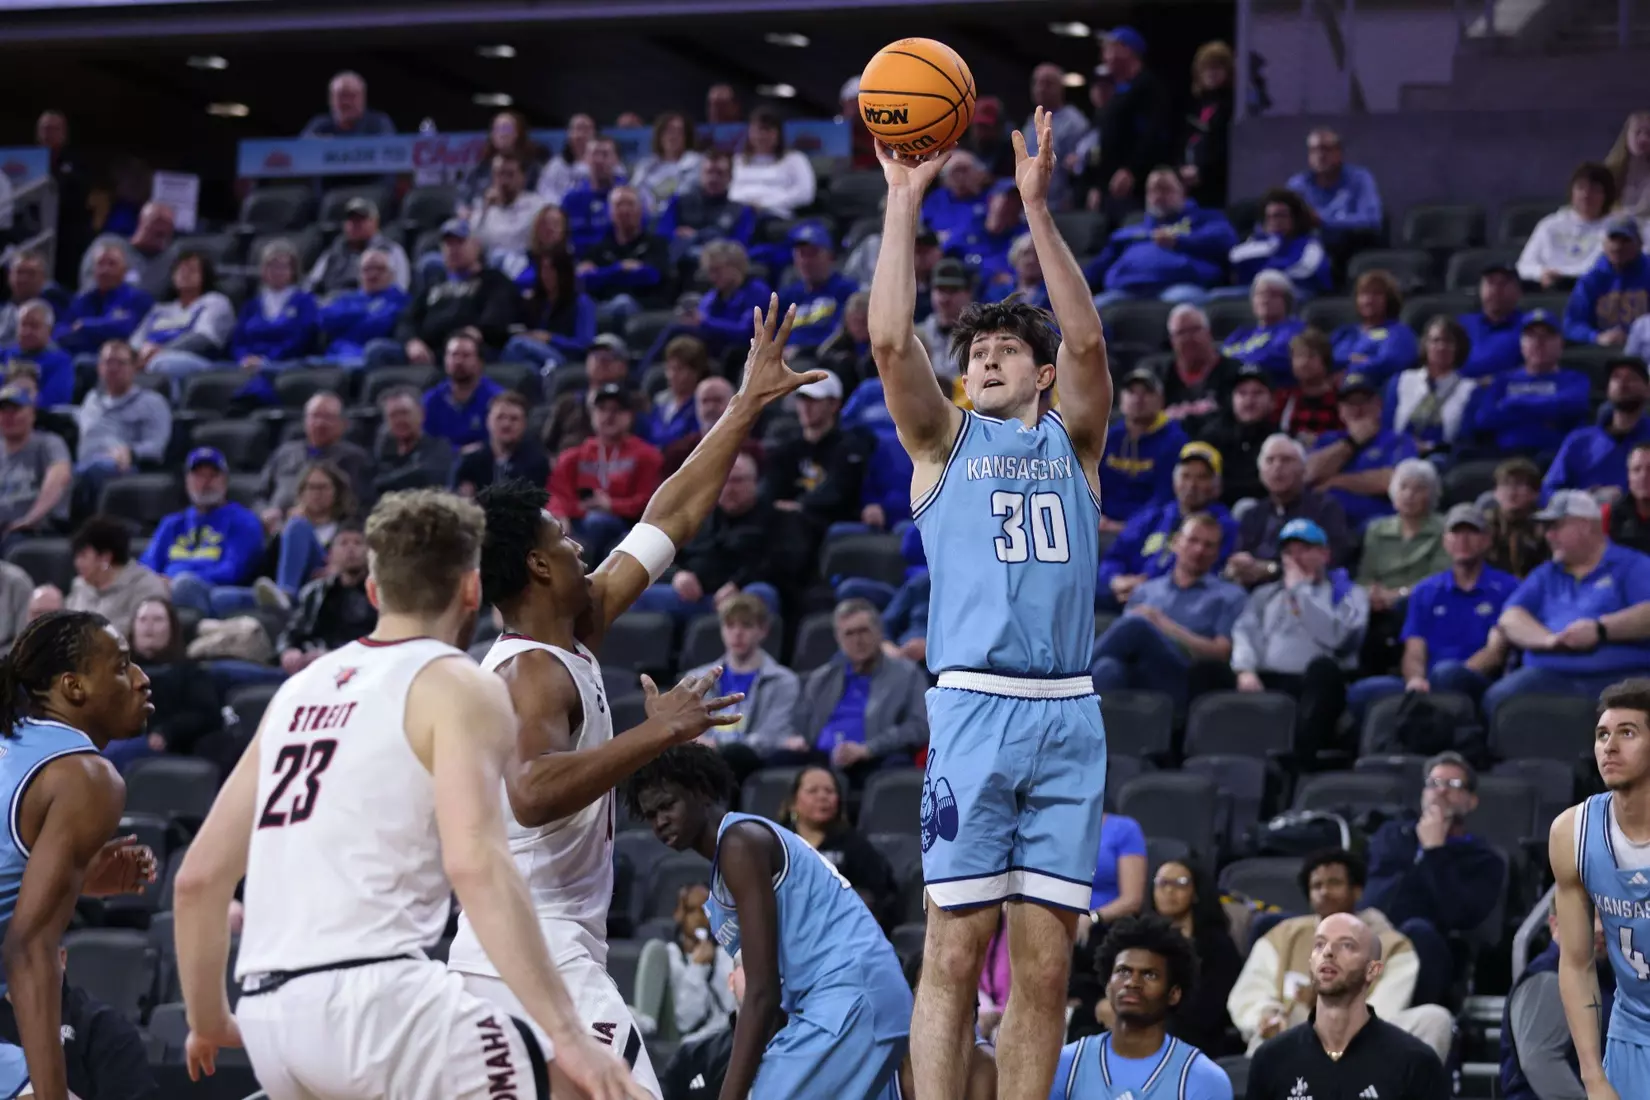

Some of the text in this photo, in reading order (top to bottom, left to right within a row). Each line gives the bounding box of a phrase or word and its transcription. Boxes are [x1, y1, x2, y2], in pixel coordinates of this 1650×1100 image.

[864, 106, 908, 125] NCAA
[990, 489, 1071, 564] 30
[288, 701, 358, 732] STREIT
[257, 738, 338, 830] 23
[1619, 925, 1650, 981] 4
